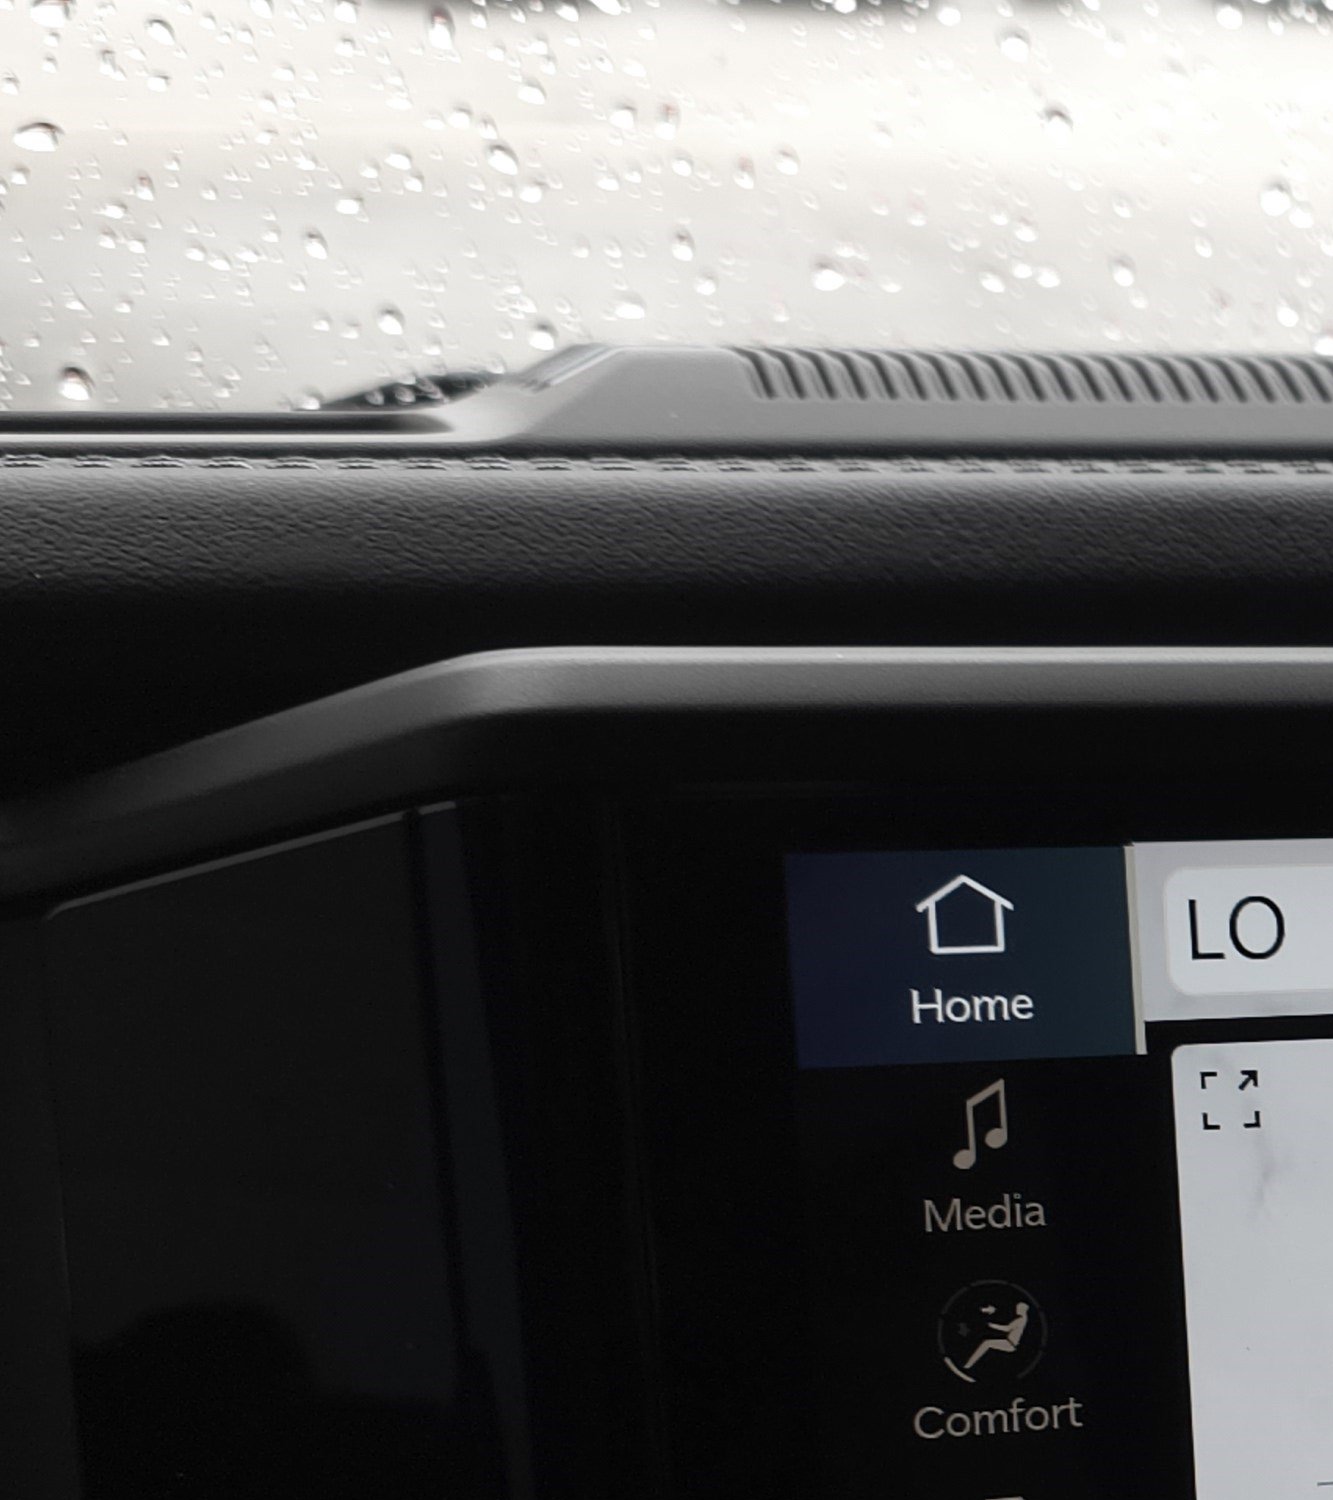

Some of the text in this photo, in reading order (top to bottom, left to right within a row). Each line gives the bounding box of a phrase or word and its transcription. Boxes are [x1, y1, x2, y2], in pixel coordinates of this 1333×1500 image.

[1188, 895, 1286, 961] LO
[911, 988, 1034, 1025] Home
[923, 1193, 1047, 1233] Media
[913, 1396, 1084, 1439] Comfort
